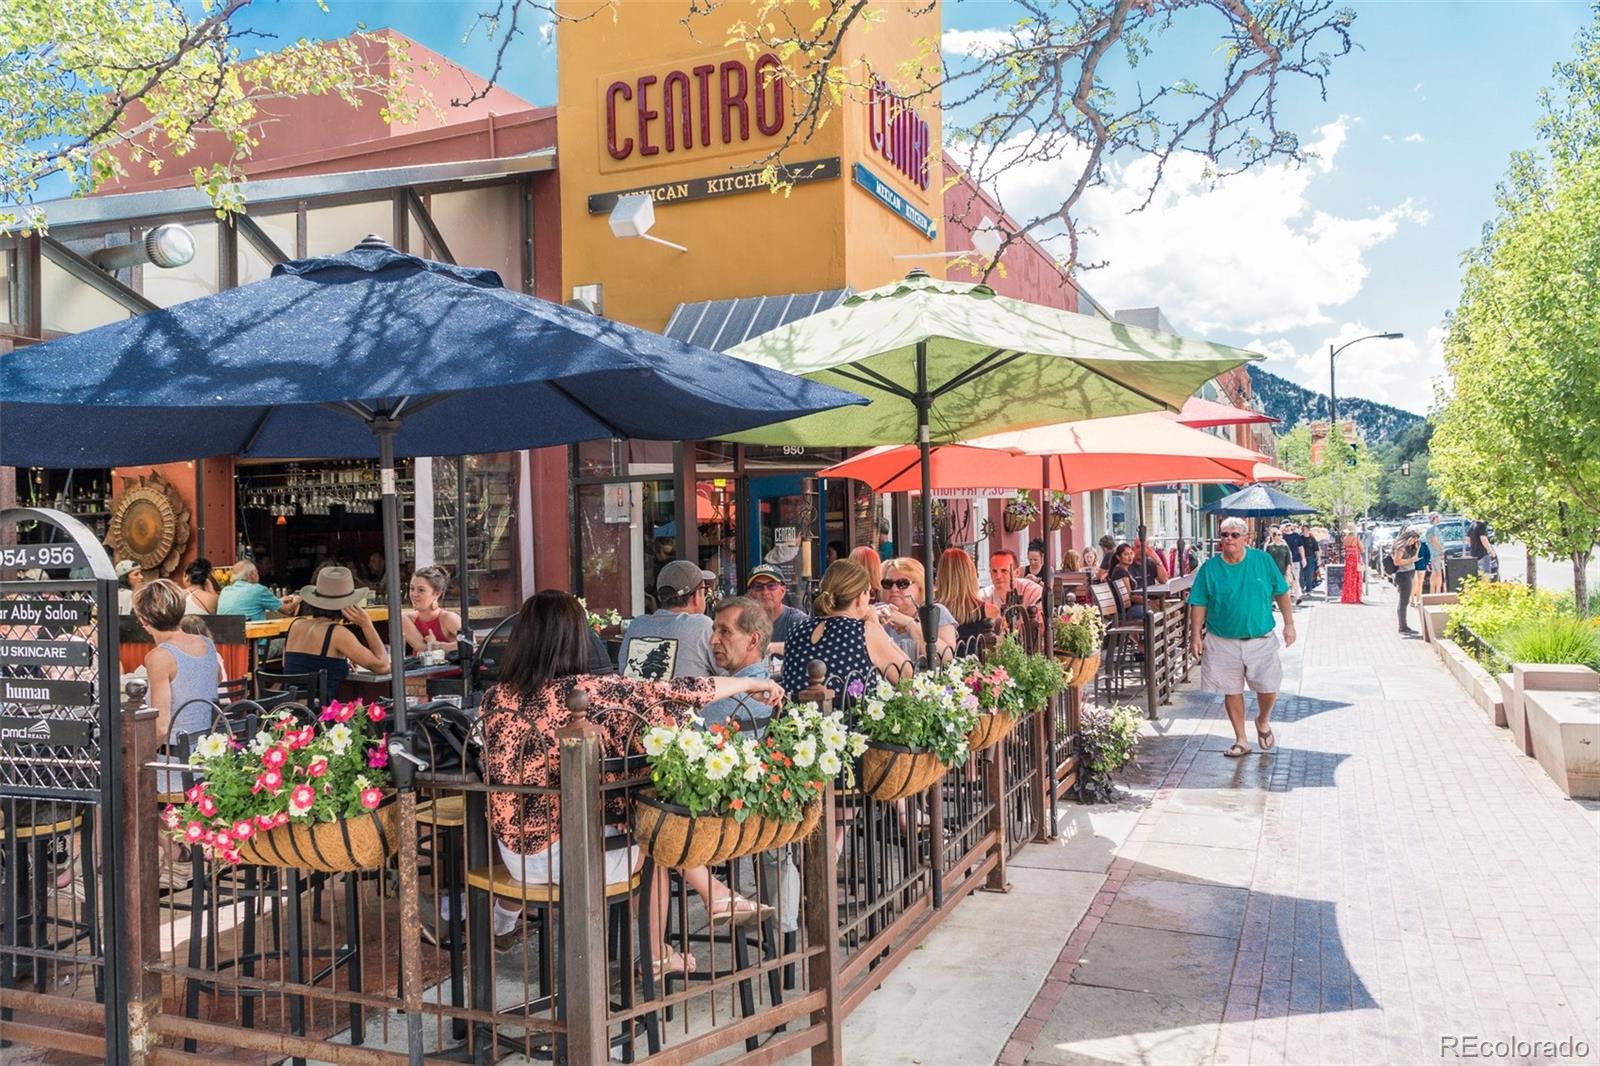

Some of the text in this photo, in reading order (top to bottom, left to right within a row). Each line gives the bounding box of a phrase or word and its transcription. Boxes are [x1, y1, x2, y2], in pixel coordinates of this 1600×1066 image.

[606, 52, 784, 160] CENTRO
[10, 603, 42, 624] Abby
[45, 603, 78, 620] Salon
[10, 646, 67, 658] SKINCARE
[5, 683, 50, 701] human
[1, 727, 27, 740] pmd
